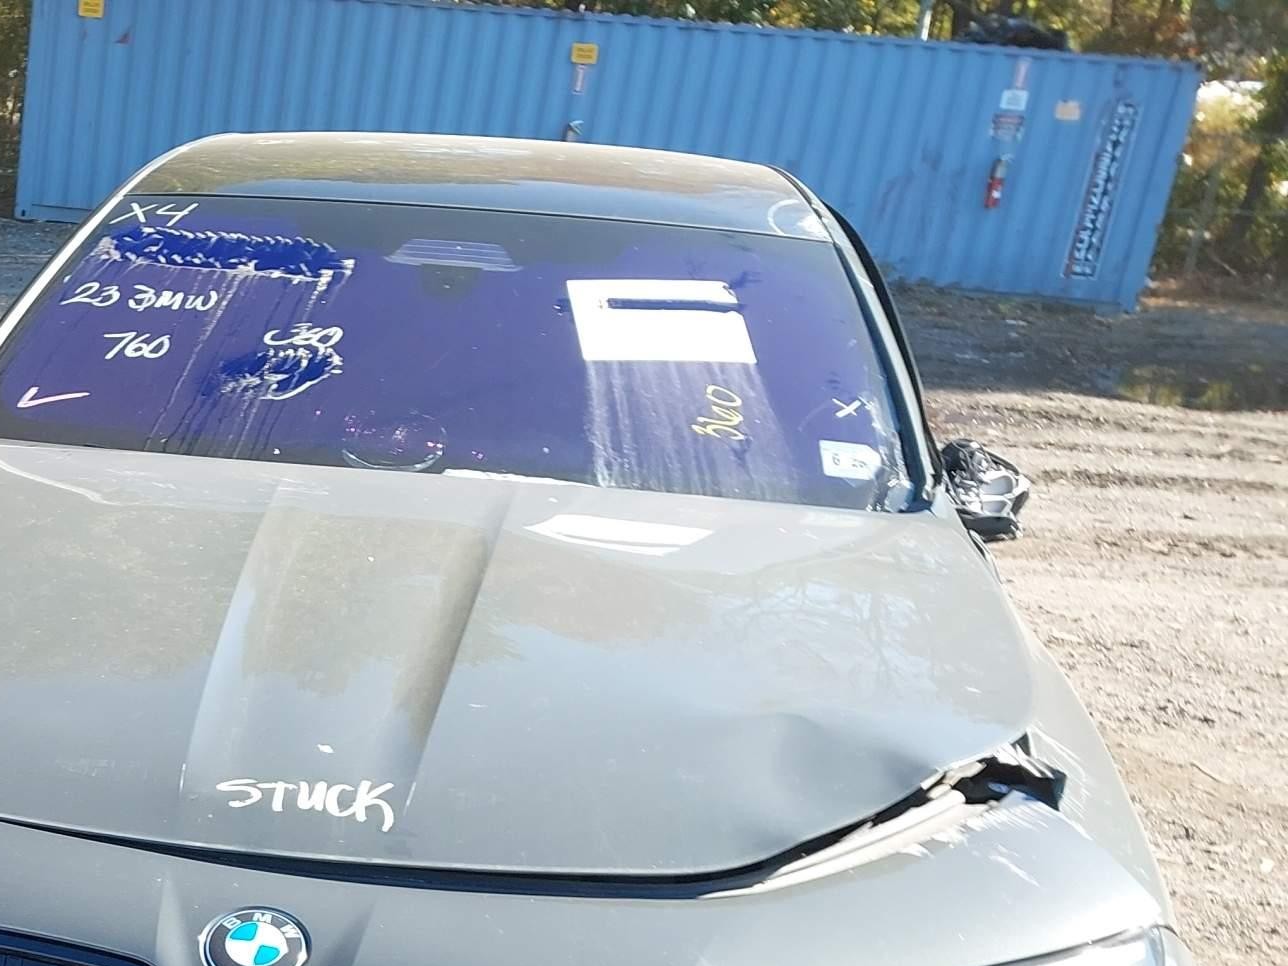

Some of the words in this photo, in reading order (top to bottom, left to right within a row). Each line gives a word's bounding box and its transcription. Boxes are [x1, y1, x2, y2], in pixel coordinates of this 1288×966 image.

[59, 281, 121, 307] 23
[103, 331, 171, 360] 760
[215, 778, 395, 832] STUCK
[221, 911, 302, 939] BMW
